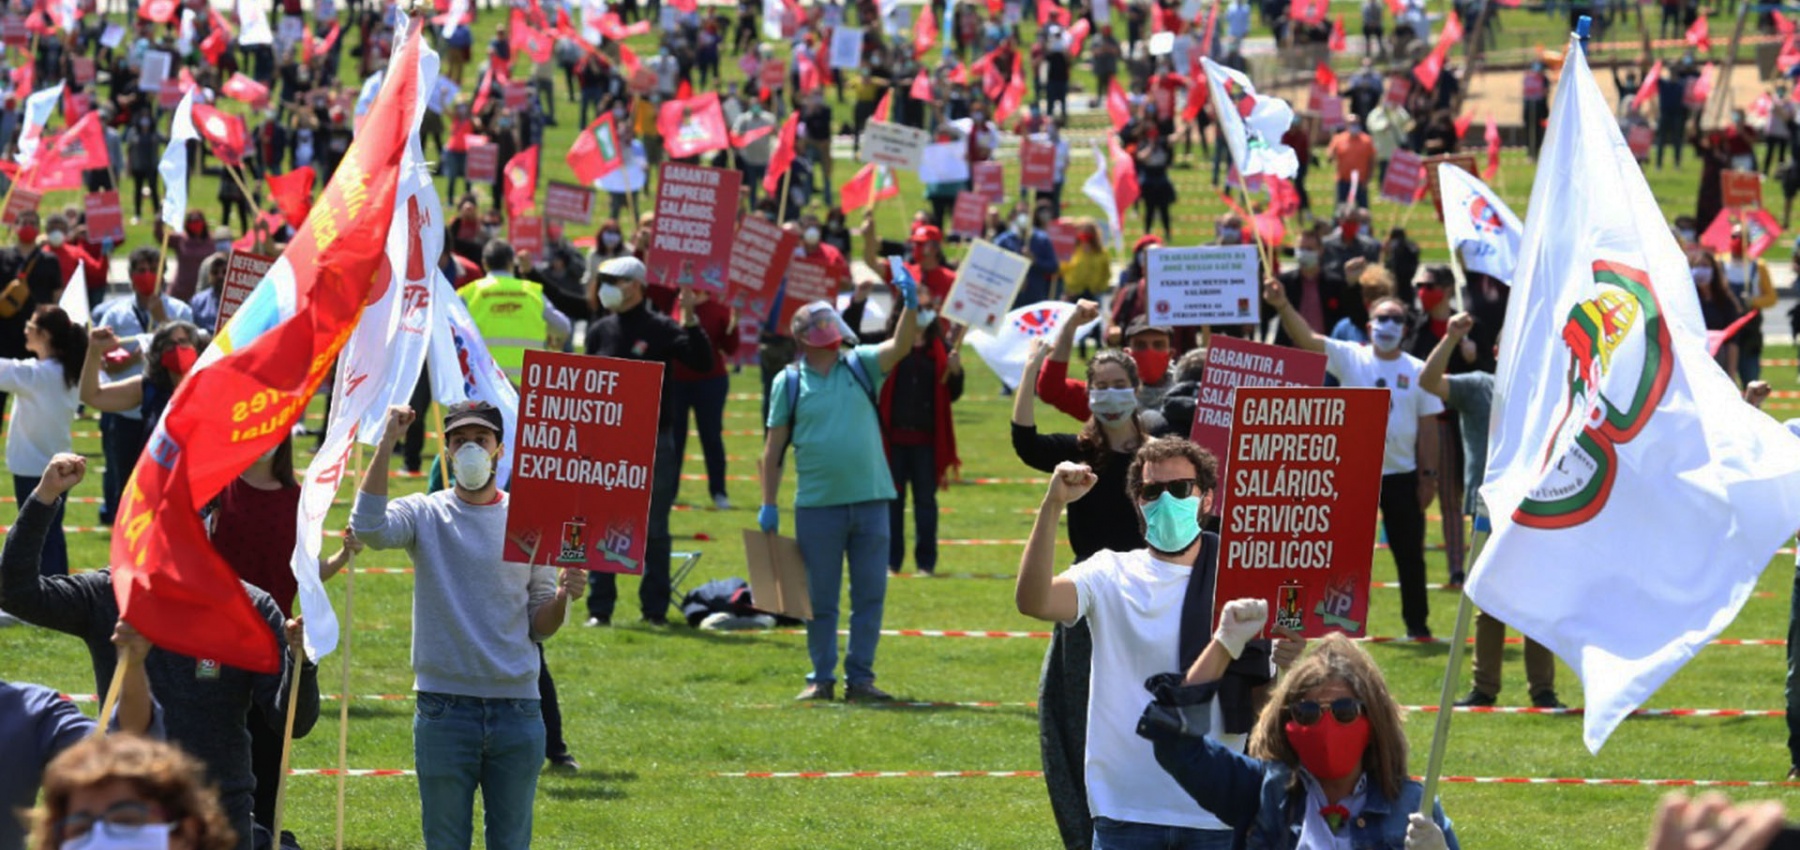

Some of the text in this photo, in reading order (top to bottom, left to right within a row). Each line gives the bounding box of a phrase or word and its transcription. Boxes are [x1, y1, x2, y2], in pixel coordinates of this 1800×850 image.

[664, 165, 720, 186] GARANTIR
[657, 217, 712, 239] SERVIÇOS
[1209, 347, 1285, 376] GARANTIR A
[528, 363, 620, 395] O LAY OFF
[525, 389, 623, 426] É INJUSTO!
[1241, 397, 1346, 427] GARANTIR
[522, 421, 578, 452] NÃO À
[1237, 433, 1341, 465] EMPREGO,
[518, 453, 647, 491] EXPLORAÇÃO!
[1234, 465, 1339, 501] SALÁRIOS,
[1230, 504, 1331, 539] SERVIÇOS
[1227, 535, 1333, 569] PÚBLICOS!
